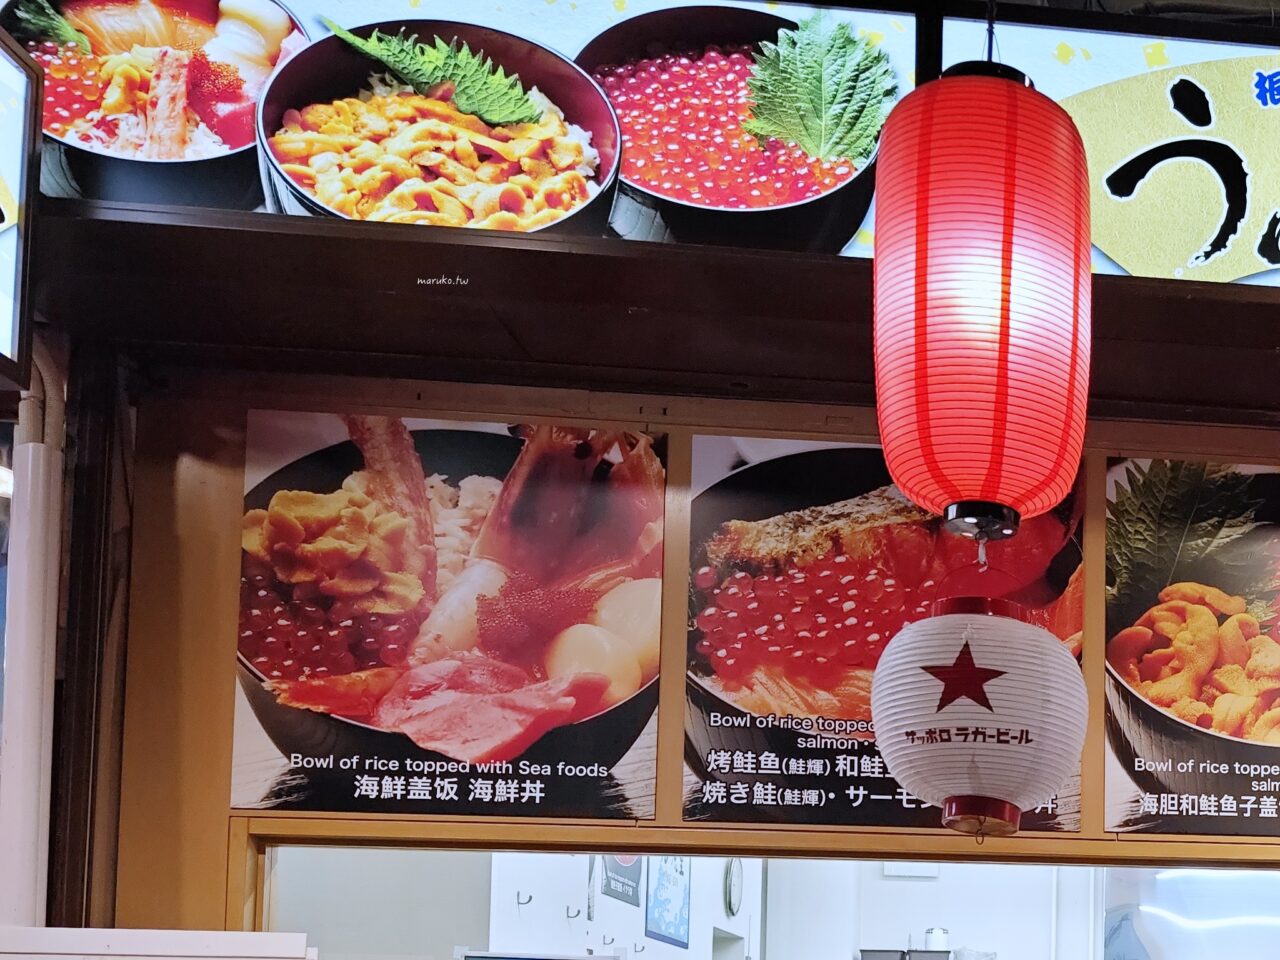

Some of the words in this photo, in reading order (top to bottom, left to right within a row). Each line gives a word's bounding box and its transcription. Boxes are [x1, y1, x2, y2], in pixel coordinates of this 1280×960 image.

[709, 712, 751, 729] Bowl
[756, 713, 776, 729] of
[780, 714, 812, 730] rice
[290, 753, 334, 770] Bowl
[340, 754, 359, 769] of
[365, 755, 399, 771] rice
[405, 758, 470, 777] topped
[475, 760, 513, 775] with
[519, 761, 551, 776] Sea
[557, 761, 608, 777] foods
[1134, 758, 1173, 773] Bowl
[1177, 759, 1194, 773] of
[1199, 760, 1229, 774] rice
[468, 777, 546, 804] 海鮮丼
